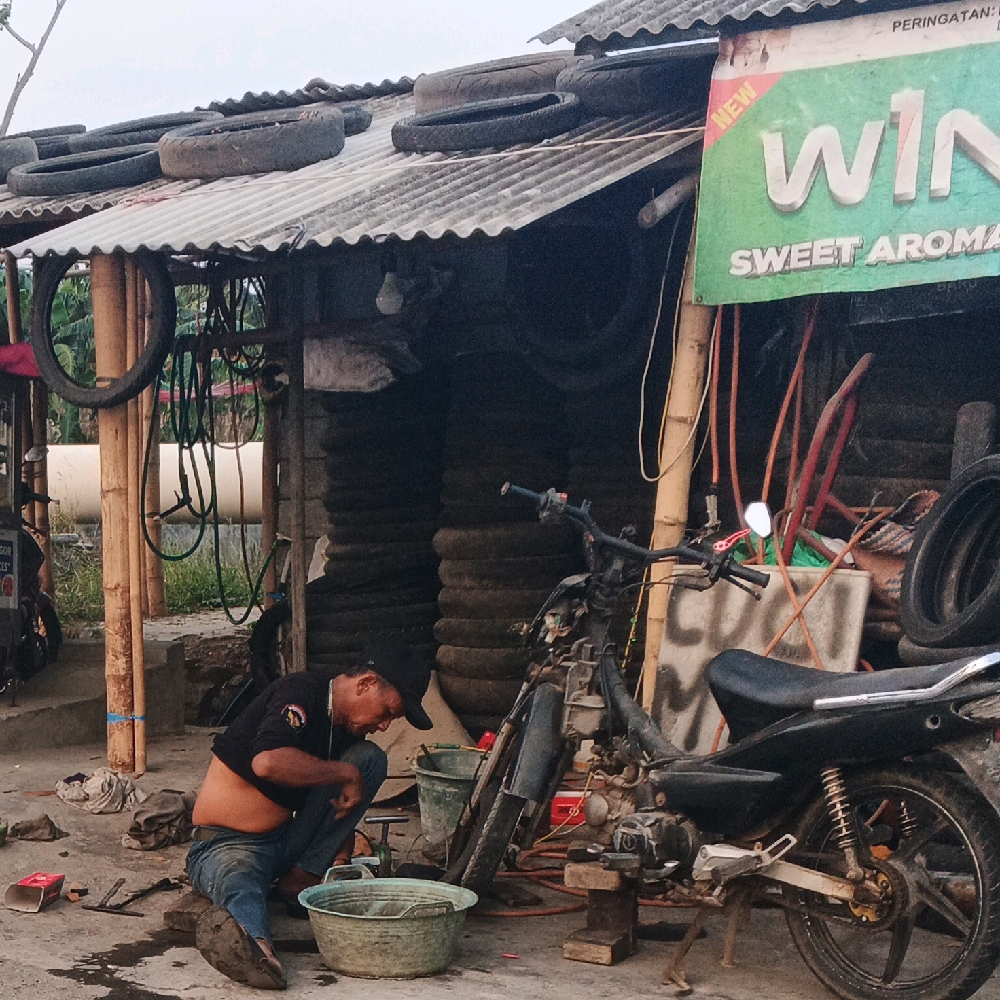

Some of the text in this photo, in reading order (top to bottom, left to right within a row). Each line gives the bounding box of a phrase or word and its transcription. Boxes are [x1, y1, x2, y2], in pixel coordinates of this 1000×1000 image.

[892, 6, 995, 33] PERINGATAN:
[711, 80, 758, 131] NEW
[729, 235, 863, 277] SWEET
[666, 570, 850, 662] CUCI
